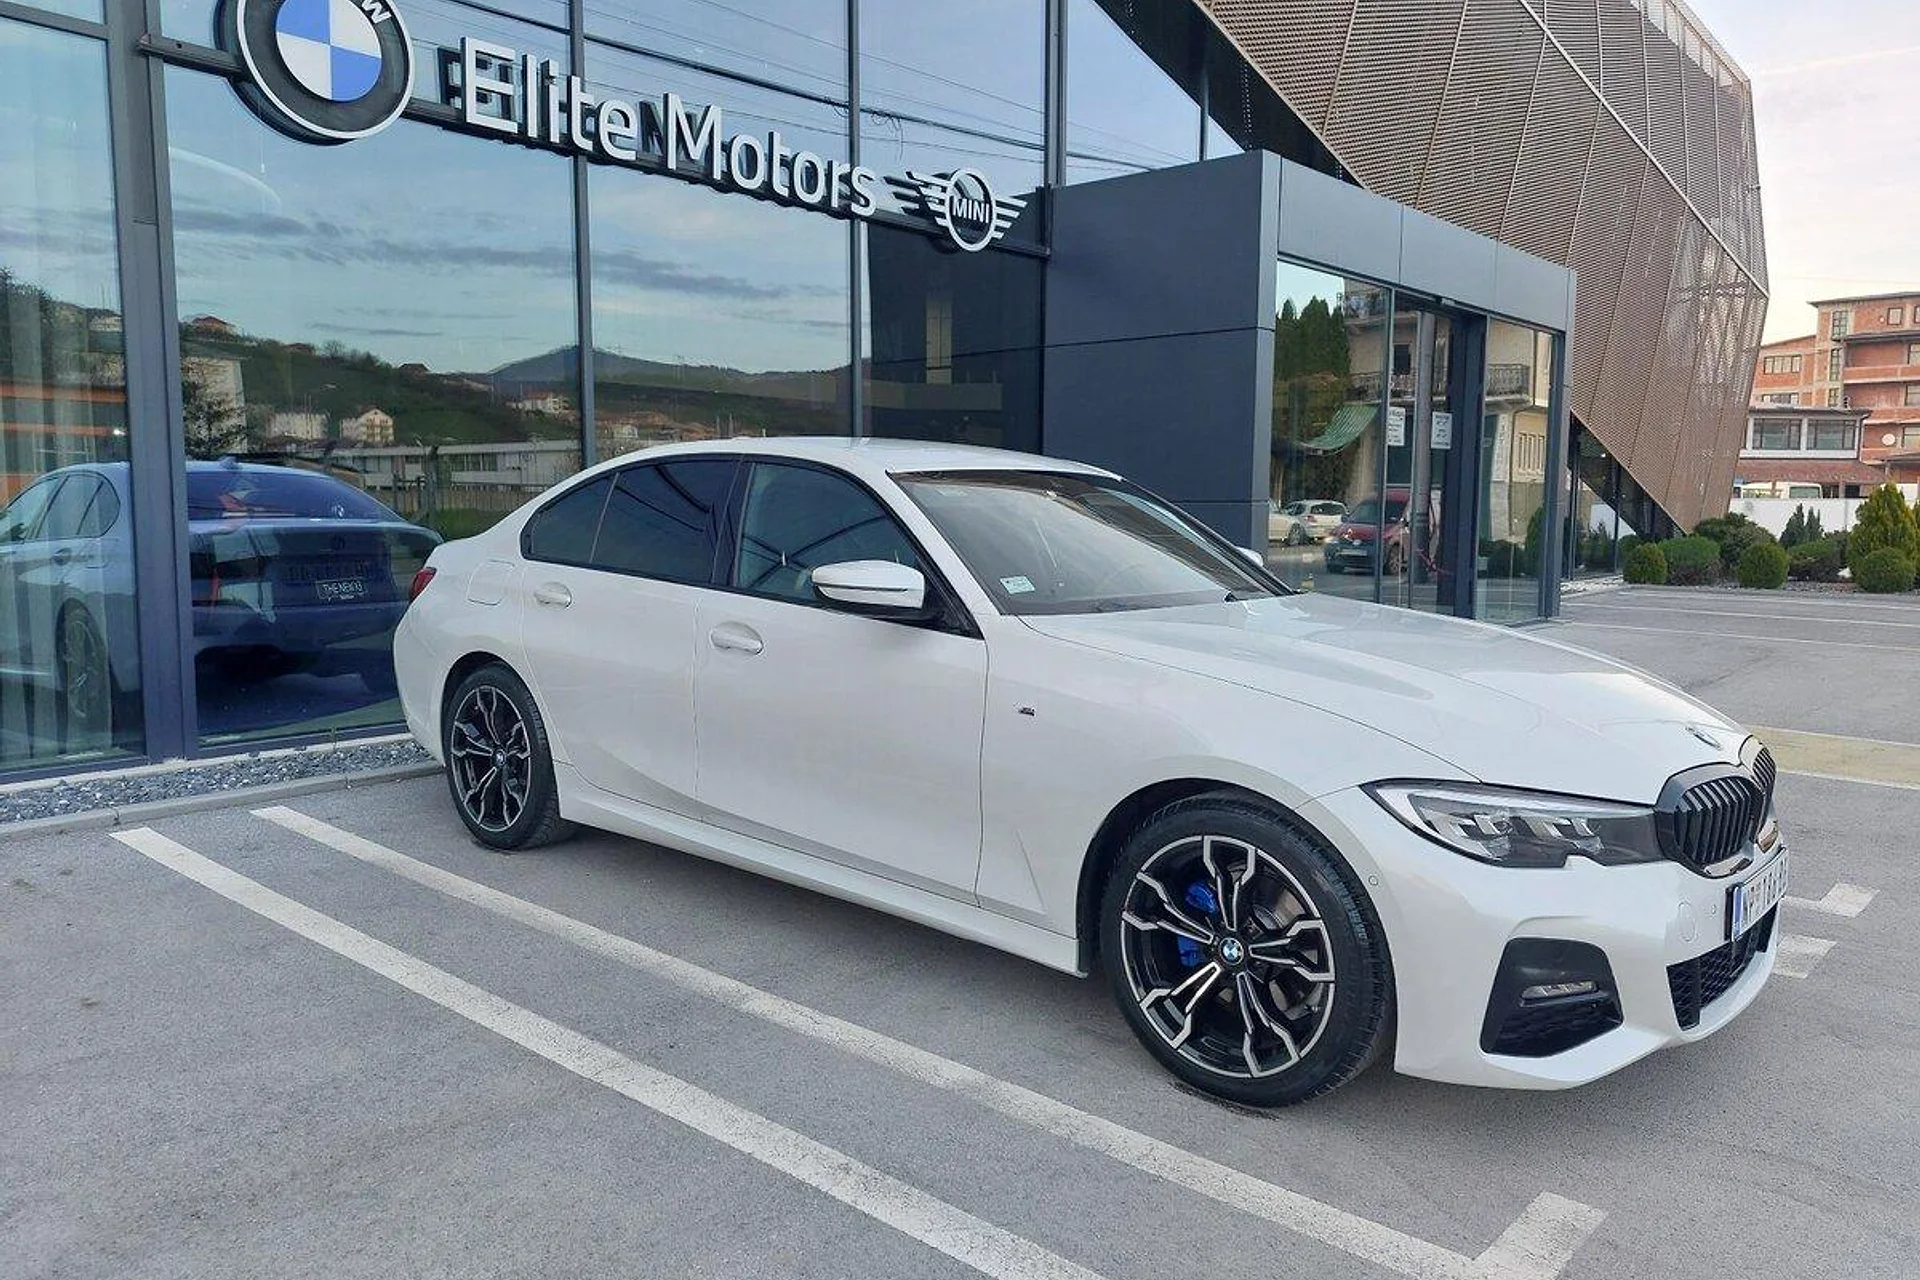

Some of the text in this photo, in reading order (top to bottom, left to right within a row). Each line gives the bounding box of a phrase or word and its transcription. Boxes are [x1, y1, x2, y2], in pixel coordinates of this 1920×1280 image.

[461, 37, 877, 217] Elite Motors
[952, 195, 990, 224] MINI
